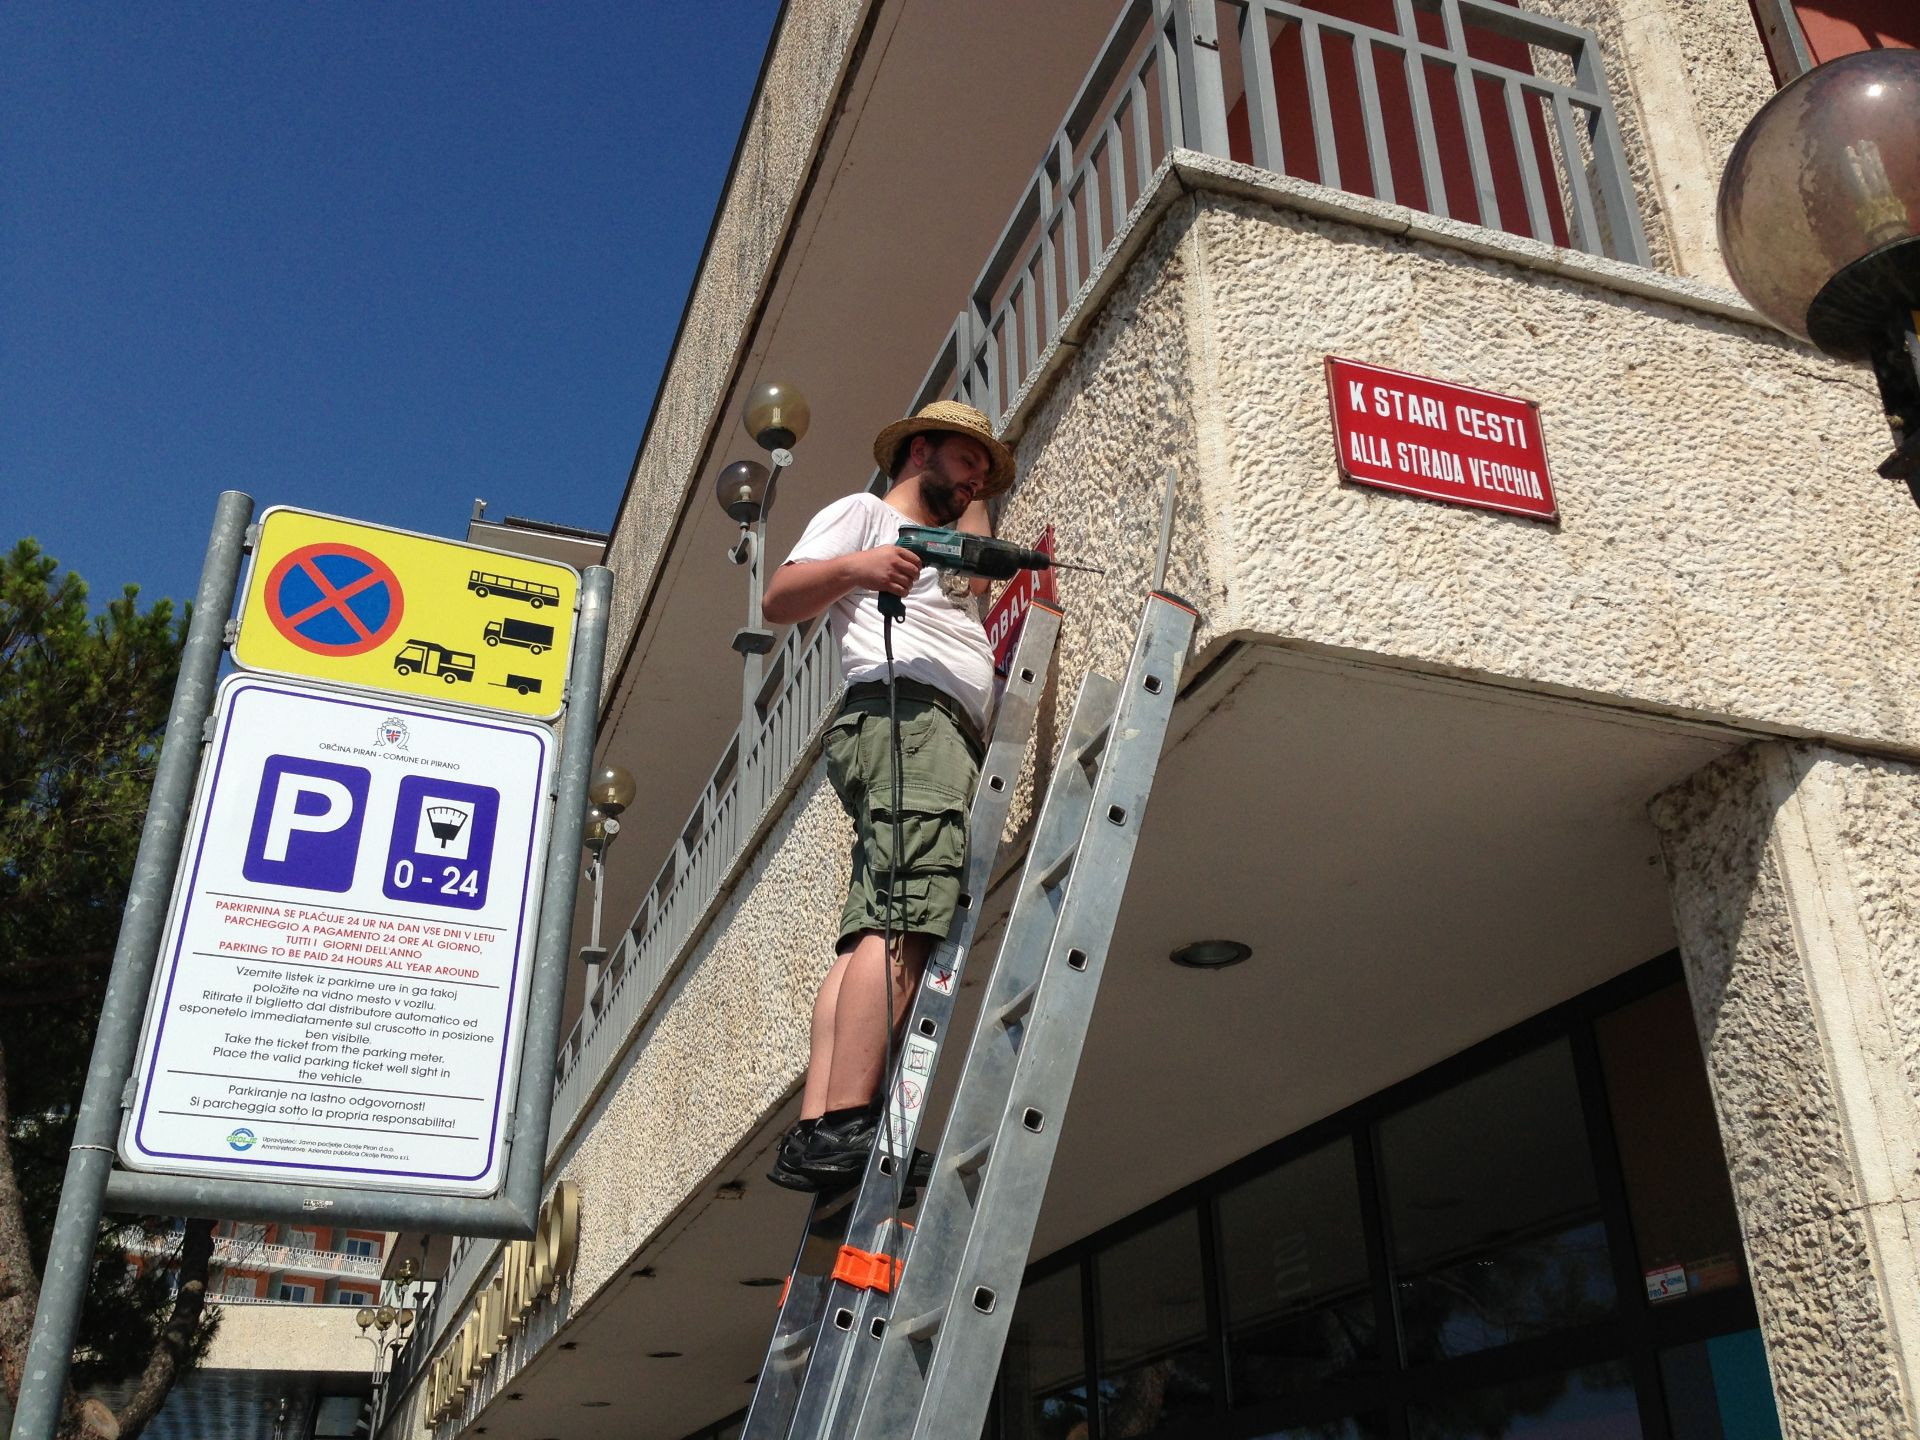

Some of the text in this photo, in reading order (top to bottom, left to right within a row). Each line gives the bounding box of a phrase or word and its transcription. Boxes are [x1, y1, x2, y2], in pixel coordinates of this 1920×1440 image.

[1349, 380, 1528, 449] K STARI CESTI
[1350, 431, 1544, 501] ALLA STRADA VECCHIA
[319, 742, 351, 753] OBČINA
[353, 747, 377, 758] PIRAN
[383, 752, 419, 764] COMUNE
[420, 758, 429, 766] DI
[430, 760, 460, 770] PIRANO
[262, 771, 354, 862] P
[393, 859, 414, 889] 0
[440, 866, 479, 898] 24
[215, 900, 495, 942] PARKIRNINA SE PLAČUJE 24 UR NA DAN VSE DNI V LETU
[224, 914, 299, 931] PARCHEGGIO
[301, 924, 310, 933] A
[313, 925, 380, 941] PAGAMENTO
[382, 933, 395, 942] 24
[398, 935, 420, 946] ORE
[421, 938, 434, 948] AL
[218, 940, 479, 978] PARKING TO BE PAID 24 HOURS ALL YEAR AROUND
[286, 935, 311, 946] TUTTI
[322, 939, 363, 952] GIORNI
[236, 966, 282, 979] Vzemite
[285, 971, 314, 982] listek
[316, 974, 325, 984] iz
[378, 983, 396, 991] ure
[398, 983, 409, 993] in
[411, 987, 428, 996] ga
[430, 987, 457, 1001] takoj
[252, 983, 300, 995] položite
[302, 989, 318, 997] na
[321, 989, 354, 1001] vidno
[356, 994, 391, 1005] mesto
[178, 1004, 247, 1017] esponetelo
[250, 1009, 353, 1028] immediatamente
[355, 1021, 372, 1030] sul
[374, 1024, 427, 1036] cruscotto
[441, 1031, 494, 1043] posizione
[202, 990, 478, 1027] Ritirate il biglietto dal distributore automatico ed
[224, 1032, 445, 1063] Take the ticket from the parking meter.
[305, 1029, 328, 1040] ben
[212, 1046, 450, 1078] Place the valid parking ticket well sight in
[298, 1069, 317, 1080] the
[189, 1096, 456, 1128] Si parcheggia sotto la propria responsabilita!
[228, 1084, 426, 1111] Parkiranje na lastno odgovornost!
